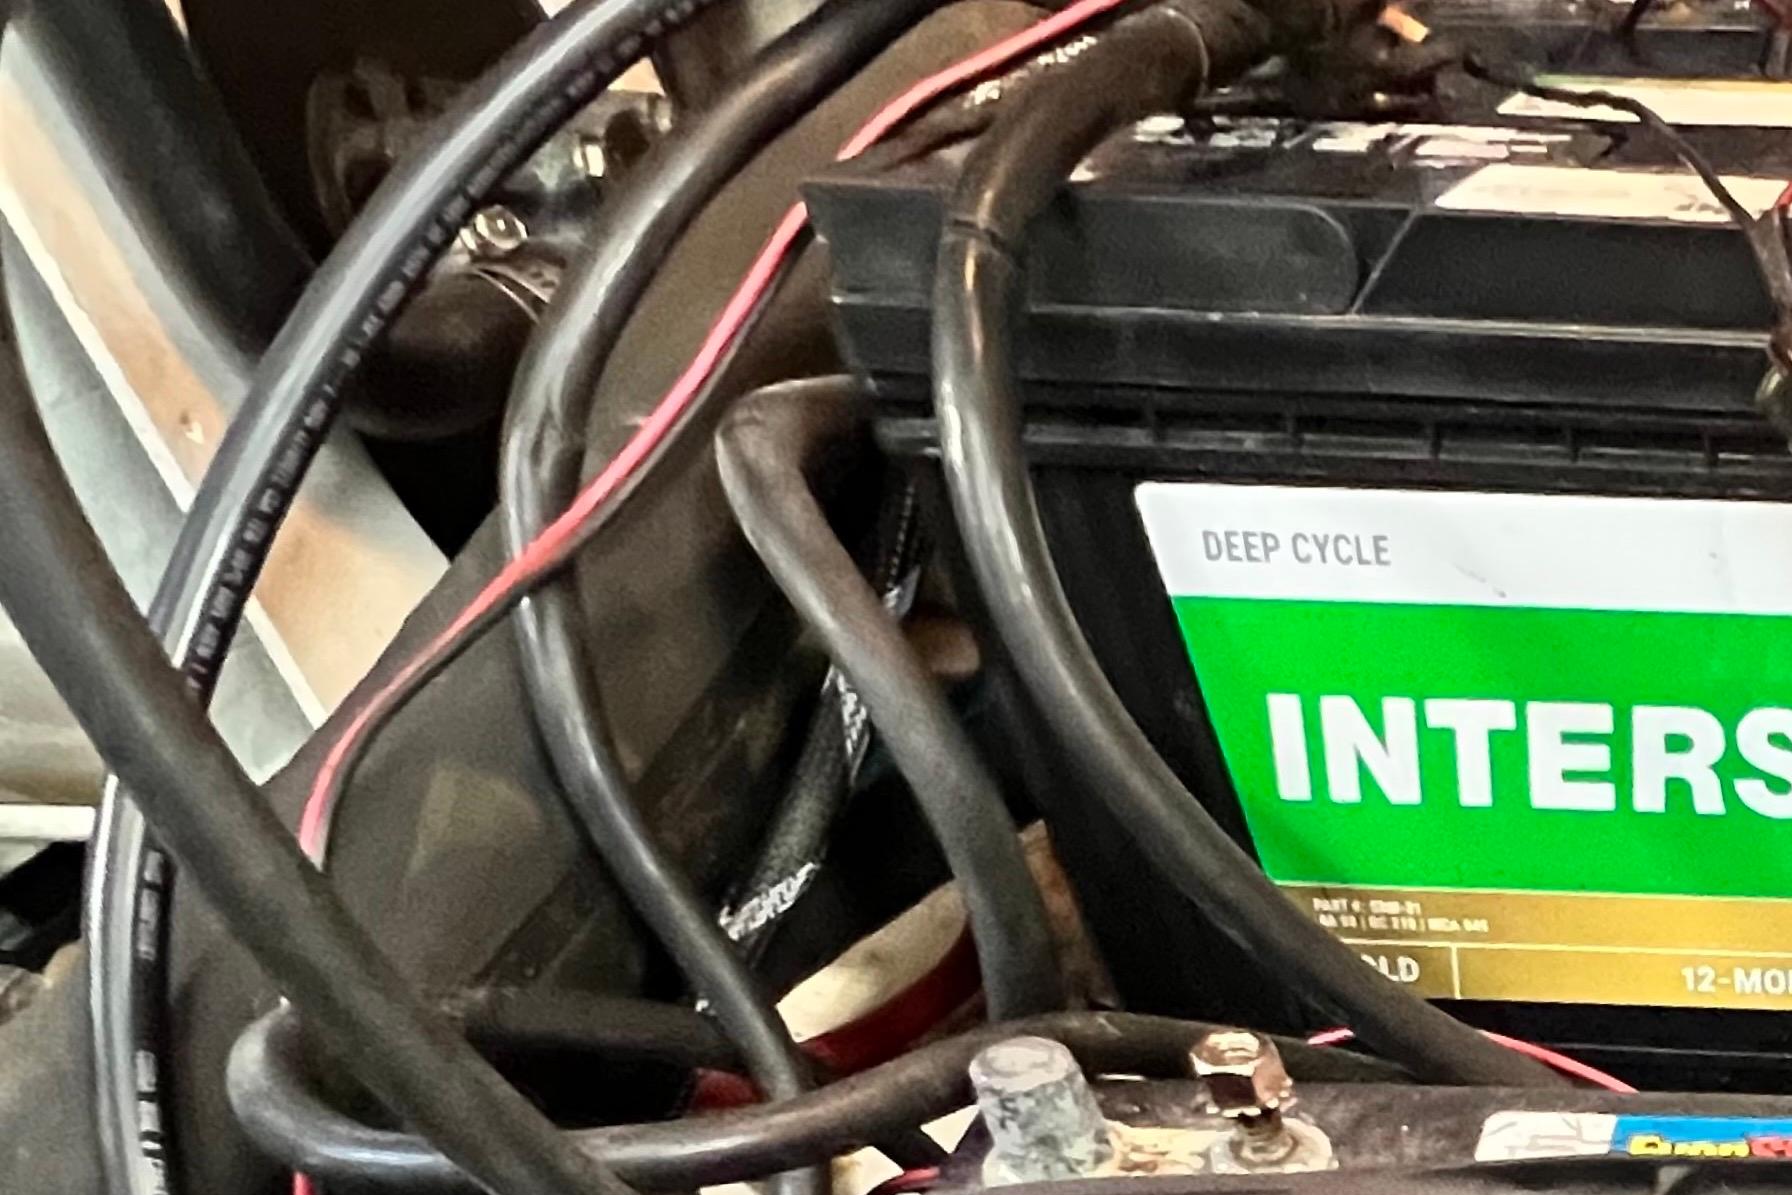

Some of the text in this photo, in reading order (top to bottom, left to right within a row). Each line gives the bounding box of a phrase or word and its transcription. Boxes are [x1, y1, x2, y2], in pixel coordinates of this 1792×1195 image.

[1202, 530, 1392, 566] DEEP CYCLE
[1360, 953, 1420, 983] LD
